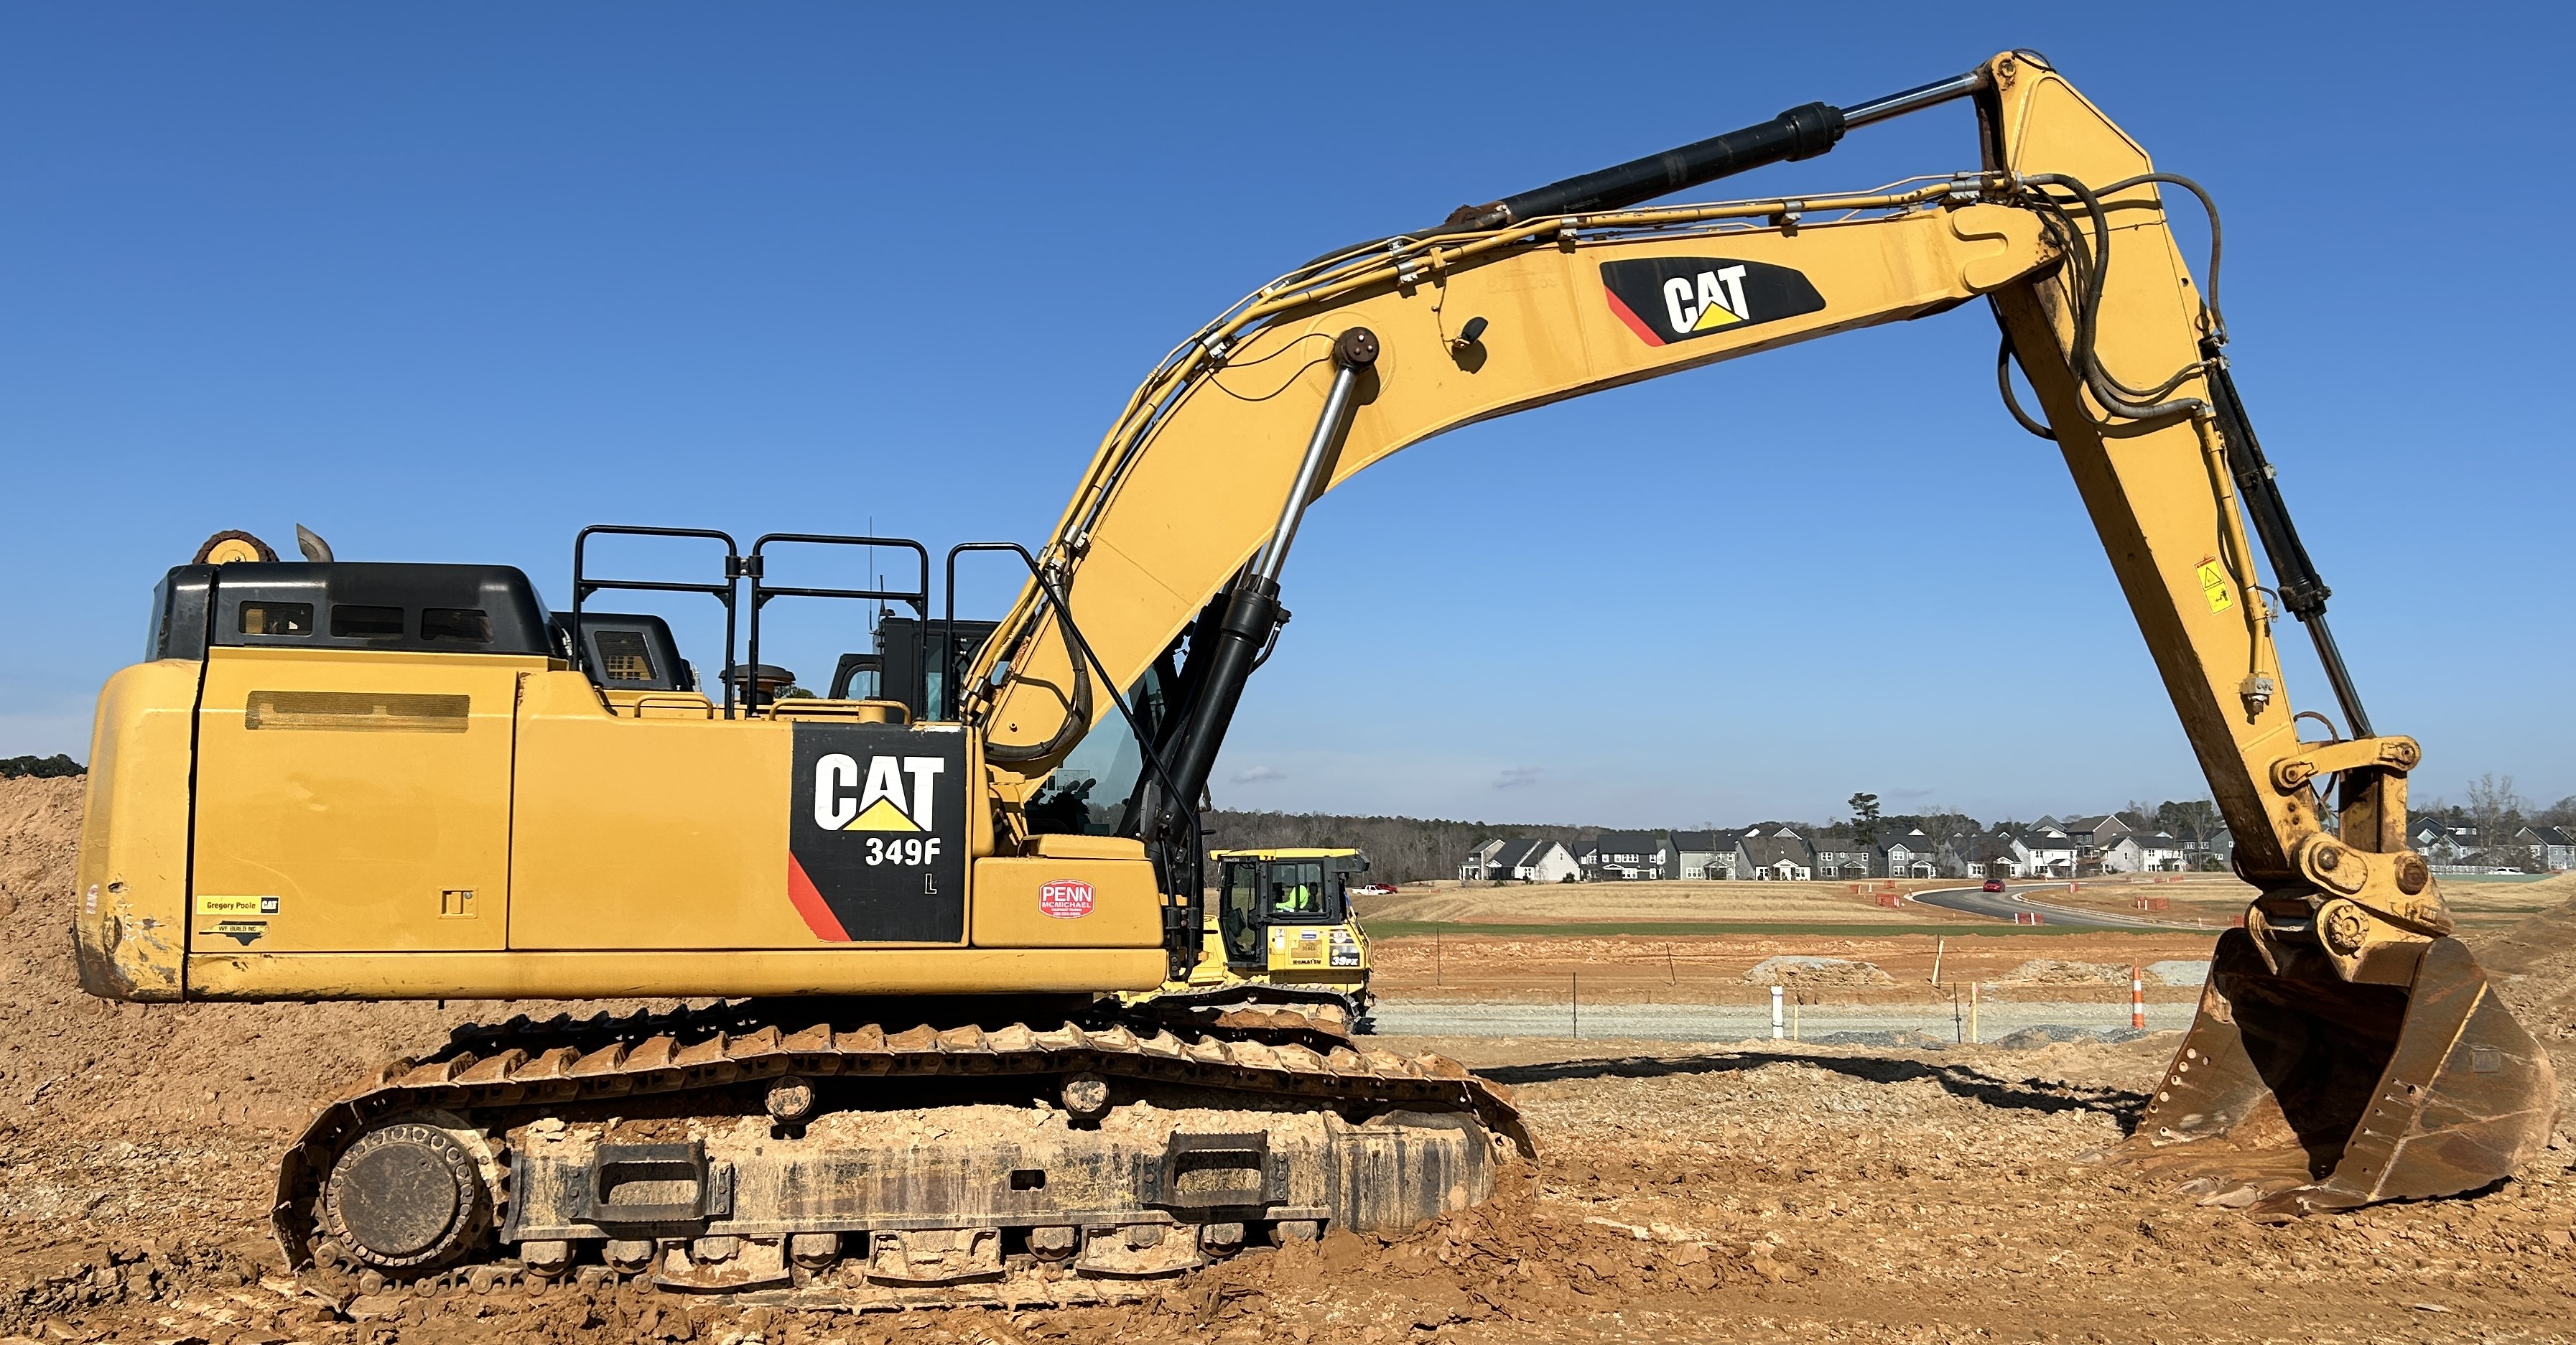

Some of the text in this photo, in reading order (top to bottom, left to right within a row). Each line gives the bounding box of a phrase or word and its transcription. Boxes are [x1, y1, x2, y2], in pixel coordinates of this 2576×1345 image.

[1663, 264, 1749, 334] CAT
[814, 753, 944, 832] CAT
[865, 837, 941, 866] 349F
[924, 873, 937, 894] L
[1043, 886, 1092, 902] PENN
[261, 900, 278, 910] CAT
